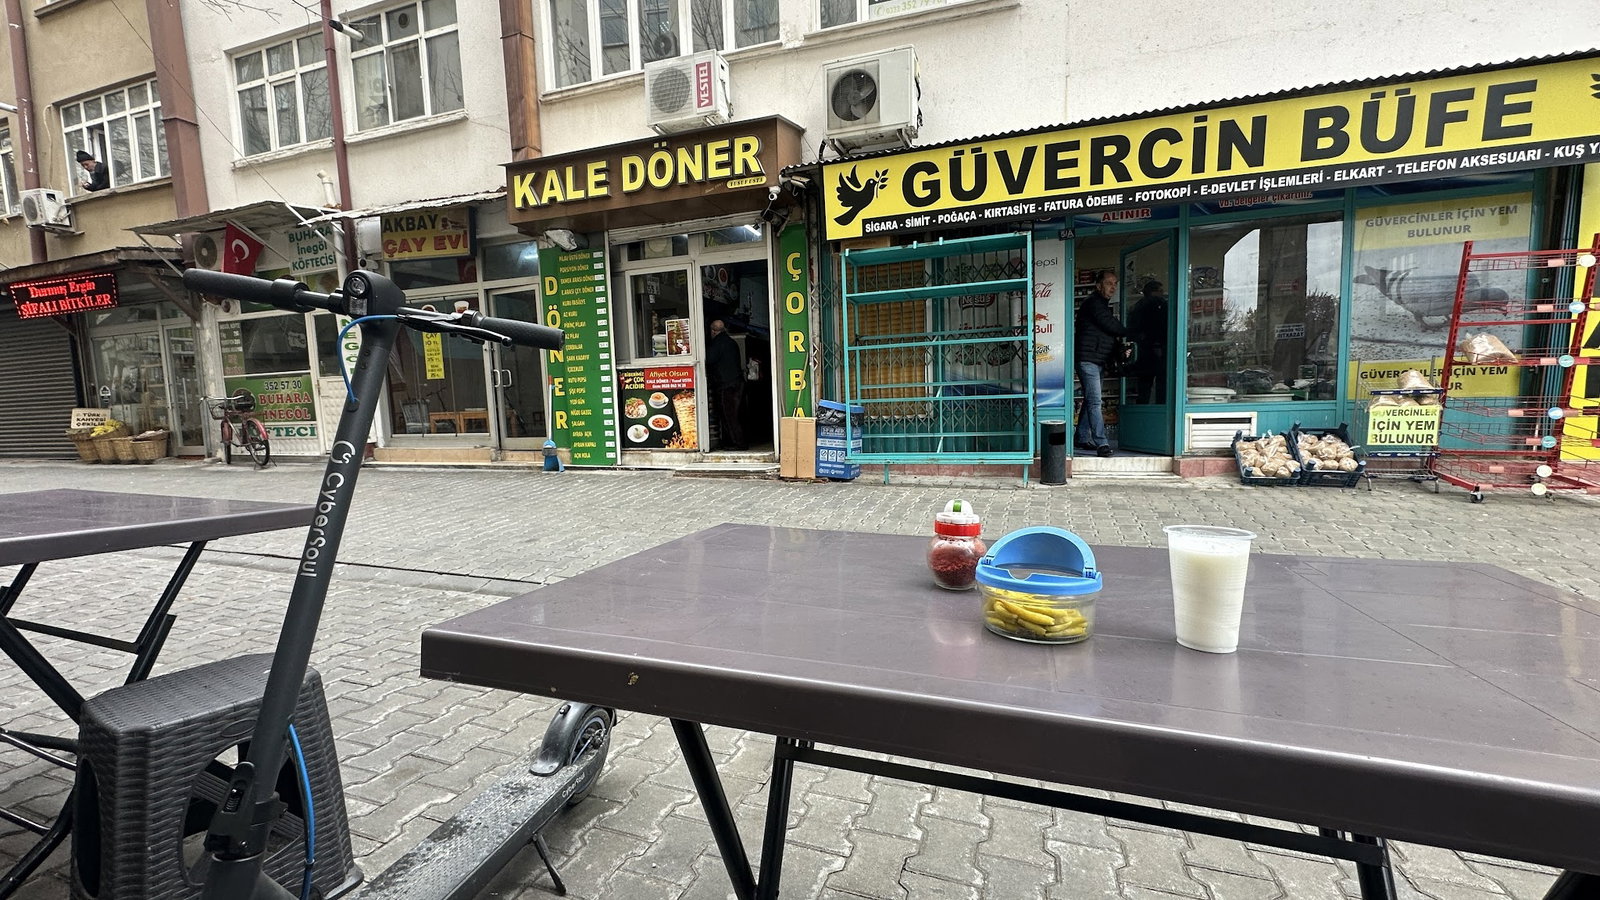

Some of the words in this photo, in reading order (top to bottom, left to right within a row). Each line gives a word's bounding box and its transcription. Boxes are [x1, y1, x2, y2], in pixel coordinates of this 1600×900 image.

[699, 62, 709, 106] VESTEL
[902, 115, 1267, 208] GÜVERCİN
[1301, 79, 1537, 162] BÜFE
[514, 161, 609, 209] KALE
[622, 135, 763, 193] DÖNER
[865, 220, 898, 233] SİGARA
[905, 216, 930, 228] SİMİT
[938, 210, 976, 226] POĞAÇA
[984, 202, 1036, 218] KIRTASİYE
[1044, 196, 1084, 212] FATURA
[1086, 194, 1123, 208] ÖDEME
[1135, 185, 1191, 202] FOTOKOPİ
[1200, 180, 1256, 195] E-DEVLET
[1259, 170, 1324, 191] İŞLEMLERİ
[1334, 166, 1385, 182] ELKART
[1396, 158, 1456, 175] TELEFON
[1460, 149, 1541, 168] AKSESUARI
[1554, 144, 1585, 158] KUŞ
[383, 214, 438, 232] AKBAY
[1102, 208, 1151, 222] ALINIR
[1366, 210, 1453, 228] GÜVERCİNLER
[1457, 206, 1485, 221] İÇİN
[1488, 205, 1518, 216] YEM
[289, 226, 332, 243] BUHARA
[1408, 224, 1471, 238] BULUNUR
[384, 237, 426, 257] ÇAY
[434, 230, 468, 250] EVİ
[292, 251, 336, 270] KÖFTECİSİ
[1036, 257, 1058, 267] epsi
[69, 280, 95, 293] Ergin
[60, 293, 112, 311] BİTKİLER
[1480, 366, 1508, 375] YEM
[265, 381, 278, 390] 352
[281, 381, 289, 389] 57
[293, 380, 301, 389] 30
[259, 393, 311, 404] BUHARA
[1373, 418, 1399, 433] İÇİN
[1406, 420, 1435, 430] YEM
[300, 472, 345, 576] CyberSoul
